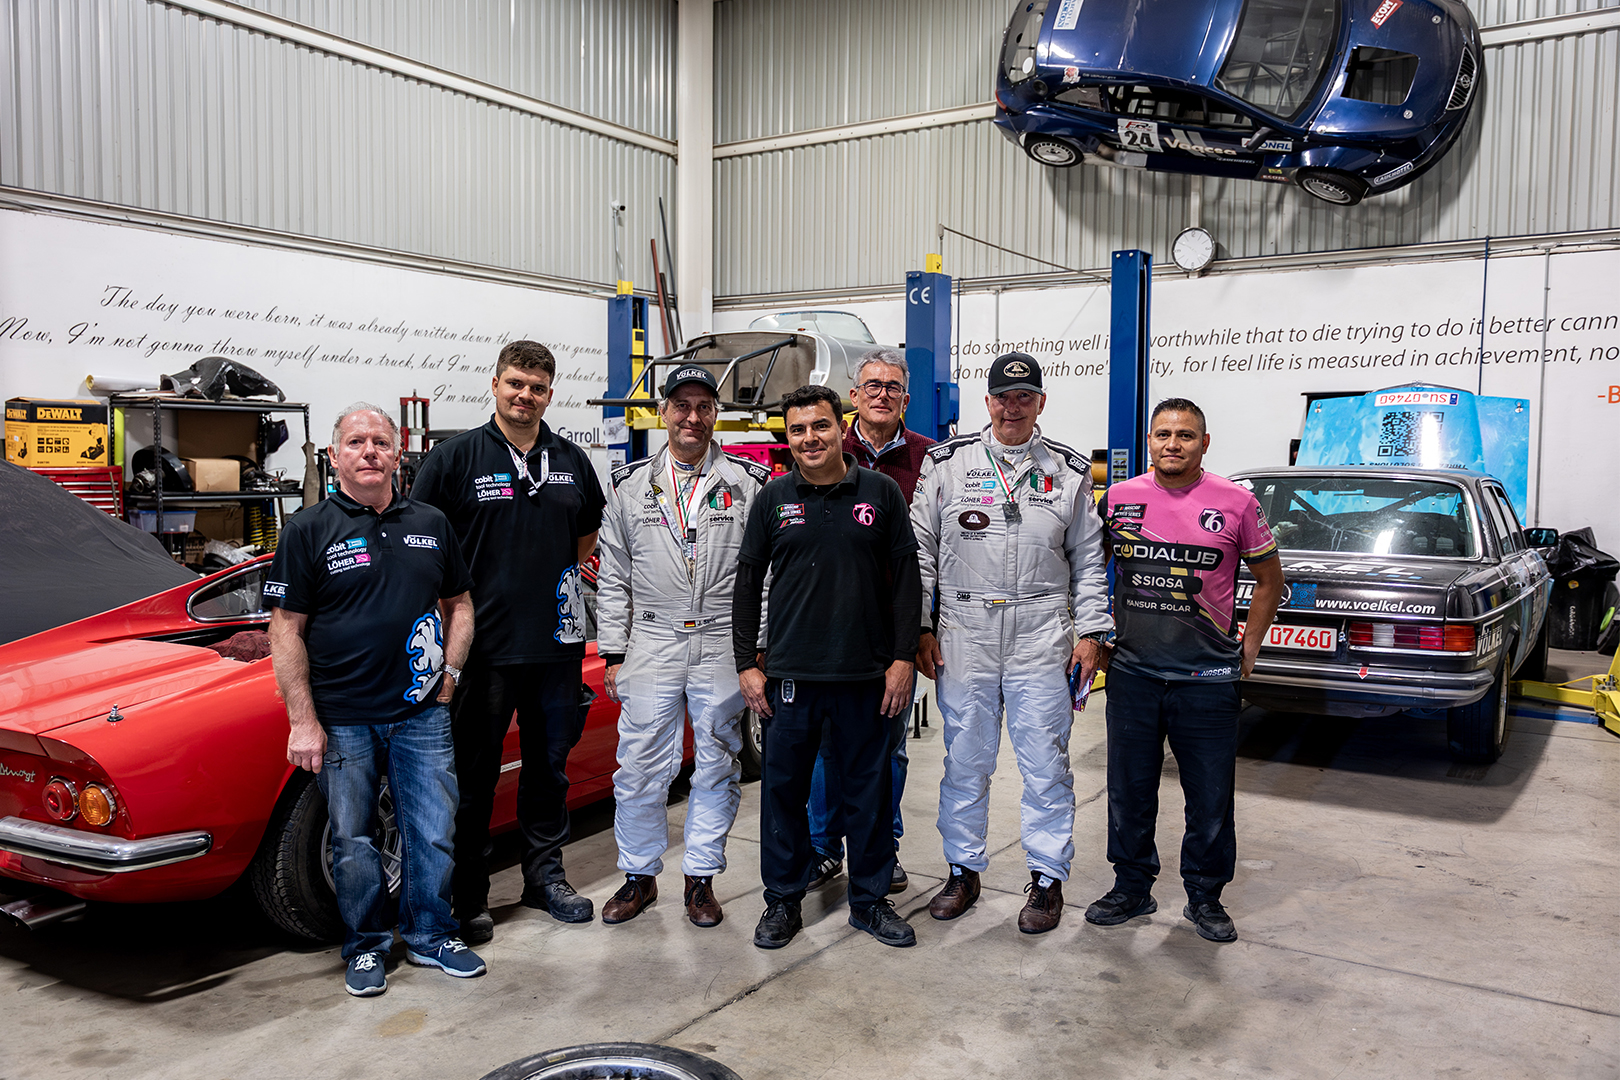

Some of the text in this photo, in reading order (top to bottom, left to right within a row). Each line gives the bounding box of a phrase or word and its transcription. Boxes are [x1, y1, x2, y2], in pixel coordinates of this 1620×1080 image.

[1124, 130, 1154, 148] 24
[909, 286, 930, 305] CE
[100, 285, 139, 310] The
[142, 293, 180, 322] day
[180, 303, 217, 324] you
[219, 309, 259, 322] were
[262, 305, 302, 328] born,
[306, 312, 325, 328] it
[324, 320, 353, 331] was
[355, 317, 410, 342] already
[410, 326, 458, 341] written
[460, 328, 493, 344] down
[570, 346, 603, 359] gonna
[1246, 325, 1284, 344] that
[1288, 326, 1307, 343] to
[1312, 324, 1341, 342] die
[1346, 321, 1405, 344] trying
[1410, 320, 1431, 339] to
[1436, 317, 1464, 336] do
[1469, 317, 1484, 335] it
[1489, 315, 1557, 334] better
[0, 316, 53, 345] Now,
[67, 321, 105, 346] I'm
[110, 332, 149, 350] not
[144, 338, 203, 359] gonna
[208, 337, 258, 357] throw
[260, 343, 319, 369] myself
[320, 348, 360, 365] under
[363, 357, 373, 366] a
[375, 351, 415, 370] truck,
[418, 354, 443, 371] but
[446, 354, 472, 373] I'm
[473, 360, 496, 374] not
[565, 367, 596, 381] about
[962, 340, 981, 356] do
[984, 336, 1064, 356] something
[1068, 333, 1102, 351] well
[1183, 355, 1208, 373] for
[1211, 356, 1217, 372] I
[1220, 352, 1254, 373] feel
[1257, 352, 1284, 372] life
[1288, 352, 1303, 370] is
[1307, 348, 1405, 369] measured
[1410, 348, 1430, 367] in
[1434, 344, 1583, 367] achievement,
[953, 364, 971, 379] do
[433, 383, 458, 402] I'm
[459, 390, 493, 411] ready
[556, 395, 582, 408] when
[1380, 393, 1448, 404] SU 07460
[37, 407, 82, 421] DEWALT
[557, 427, 600, 443] Carroll
[474, 476, 494, 485] cobit
[548, 474, 574, 482] ÖLKEL
[477, 489, 501, 498] LÖHER
[855, 504, 873, 526] 76
[1202, 508, 1222, 533] 76
[403, 535, 438, 547] VÖLKEL
[337, 547, 367, 557] technology
[1113, 543, 1218, 566] CODIALUB
[327, 557, 355, 571] LÖHER
[1142, 575, 1184, 590] SIQSA
[1126, 599, 1191, 613] MANSUR SOLAR
[1315, 599, 1436, 615] www.voelkel.com
[1270, 626, 1331, 649] 07460
[1200, 667, 1232, 677] NASCAR
